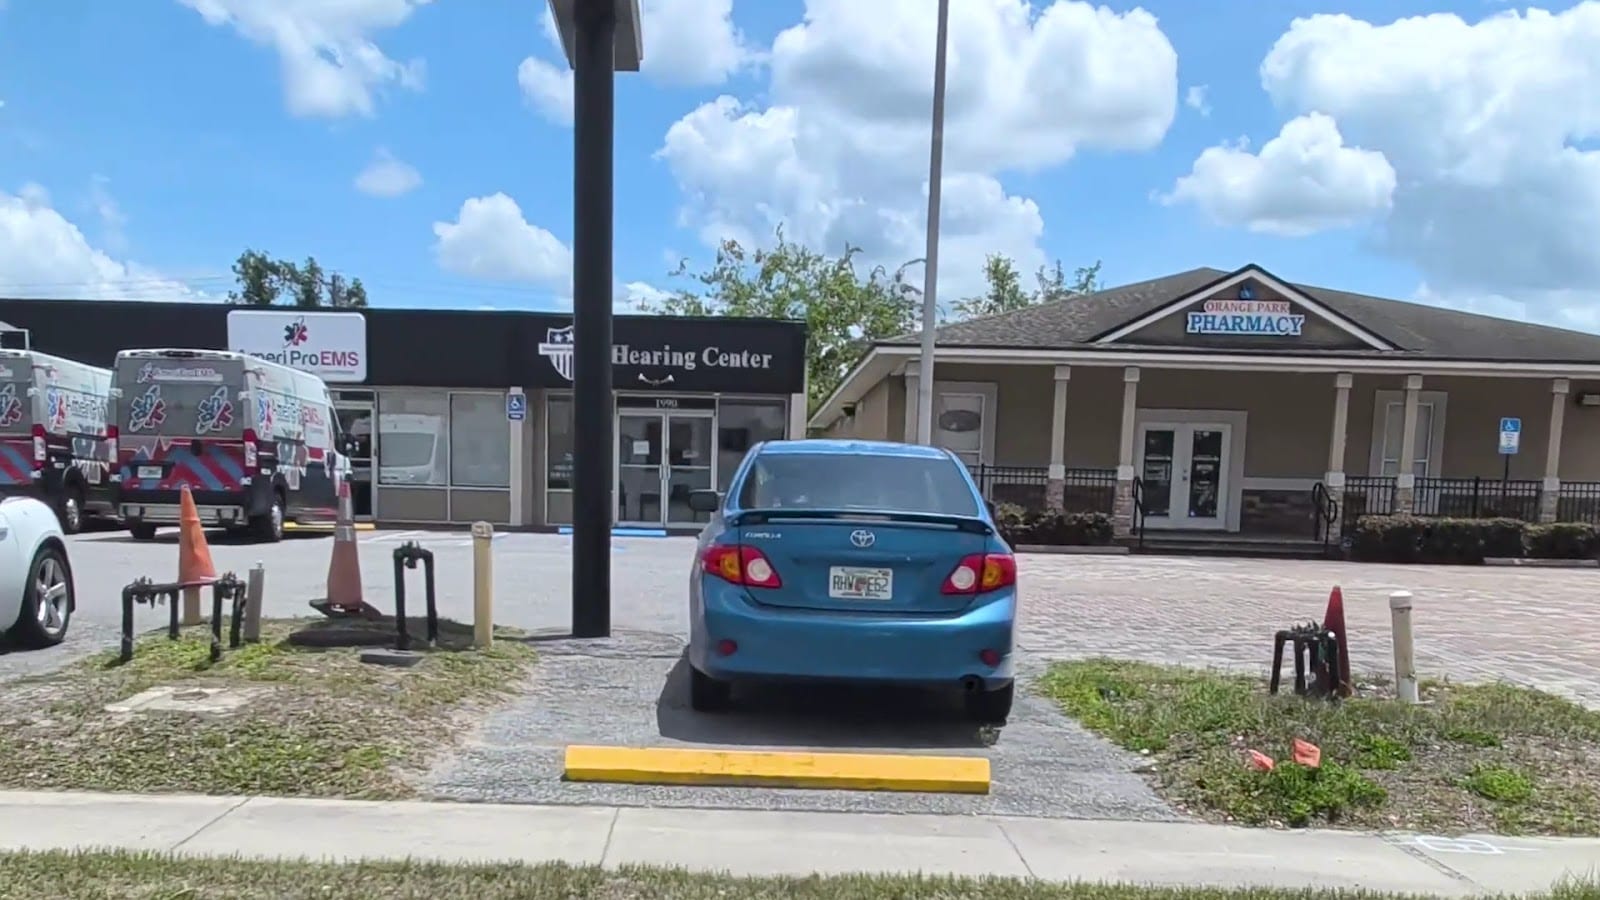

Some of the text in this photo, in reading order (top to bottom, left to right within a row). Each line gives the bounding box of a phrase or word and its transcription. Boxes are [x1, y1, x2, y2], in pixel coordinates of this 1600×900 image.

[1205, 302, 1289, 313] ORANGE PARK
[1189, 314, 1304, 333] PHARMACY
[611, 345, 772, 370] Hearing Center
[656, 399, 679, 409] 1990
